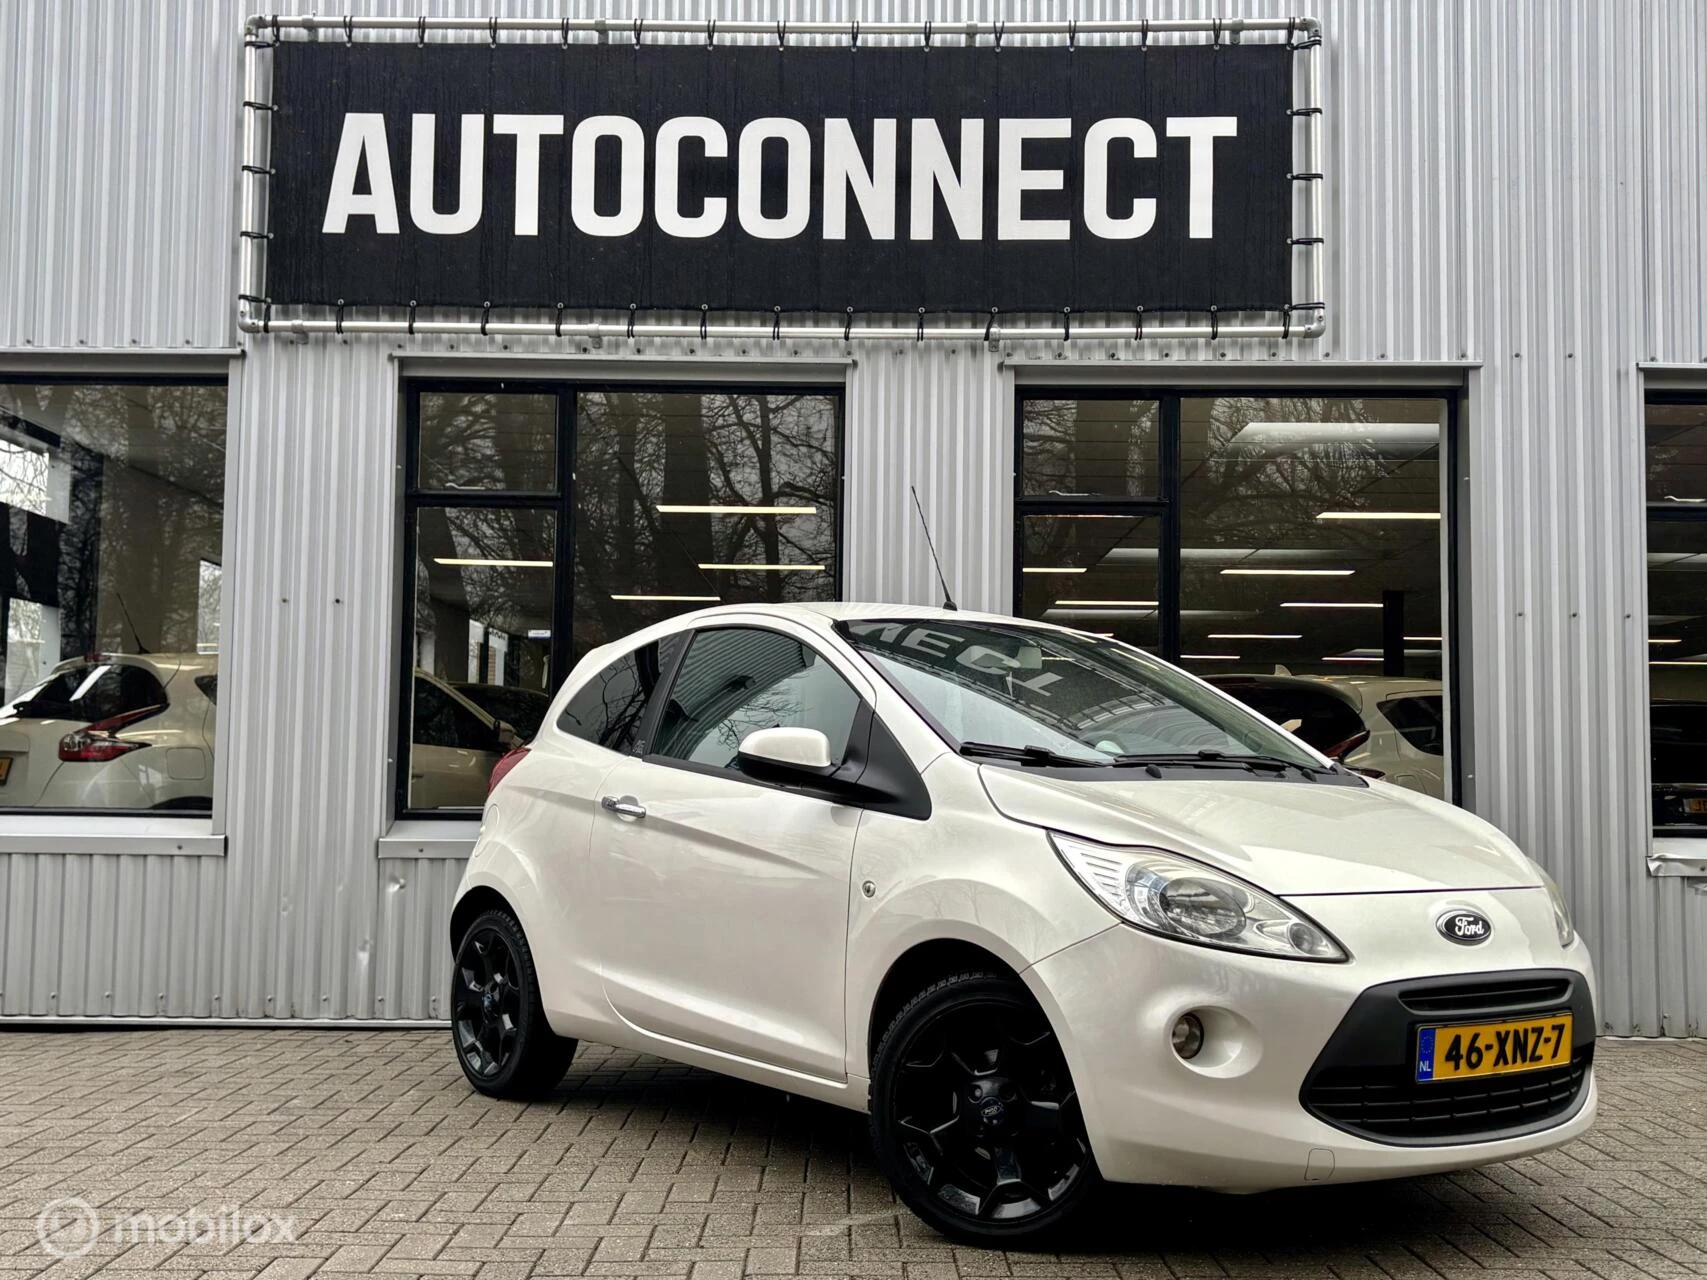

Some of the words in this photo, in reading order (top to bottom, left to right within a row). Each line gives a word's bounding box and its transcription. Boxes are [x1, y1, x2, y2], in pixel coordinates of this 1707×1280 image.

[322, 112, 1238, 241] AUTOCONNECT
[1455, 917, 1484, 936] Ford
[1445, 1024, 1565, 1071] 46-XNZ-7
[1419, 1060, 1432, 1073] NL
